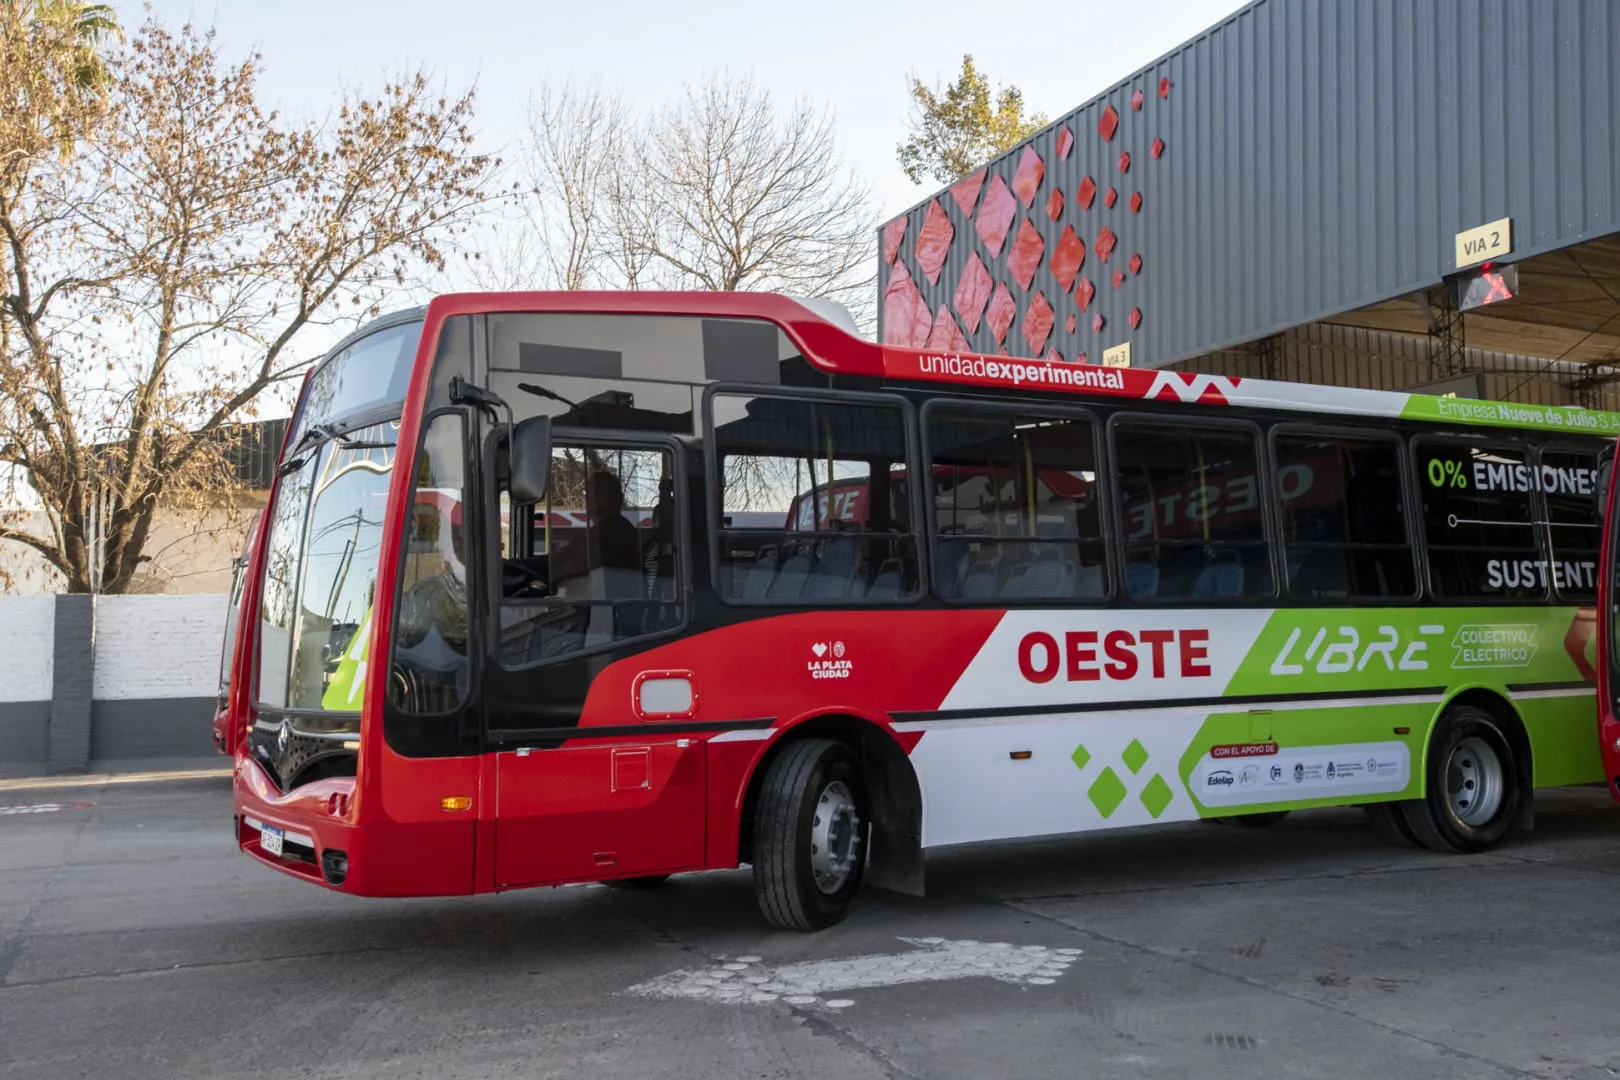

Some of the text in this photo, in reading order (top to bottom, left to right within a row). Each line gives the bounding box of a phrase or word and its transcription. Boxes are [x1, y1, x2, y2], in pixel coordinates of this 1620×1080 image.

[1463, 231, 1501, 256] VIA 2
[1120, 350, 1126, 363] 3
[919, 353, 1125, 389] unidadexperimental
[1437, 399, 1497, 420] Empresa
[1498, 404, 1543, 424] Nueve
[1545, 408, 1563, 426] de
[1565, 410, 1597, 428] Julio
[1428, 458, 1468, 489] 0%
[1487, 559, 1600, 588] SUSTENT
[1461, 629, 1528, 644] COLECTIVO
[1018, 629, 1211, 684] OESTE
[1270, 624, 1445, 675] LIBRE
[1463, 649, 1528, 662] ELECTRICO
[807, 660, 853, 670] LA PLATA
[812, 669, 849, 679] CIUDAD
[1214, 743, 1275, 756] CON EL APOYO DE
[1207, 776, 1234, 787] Edelap
